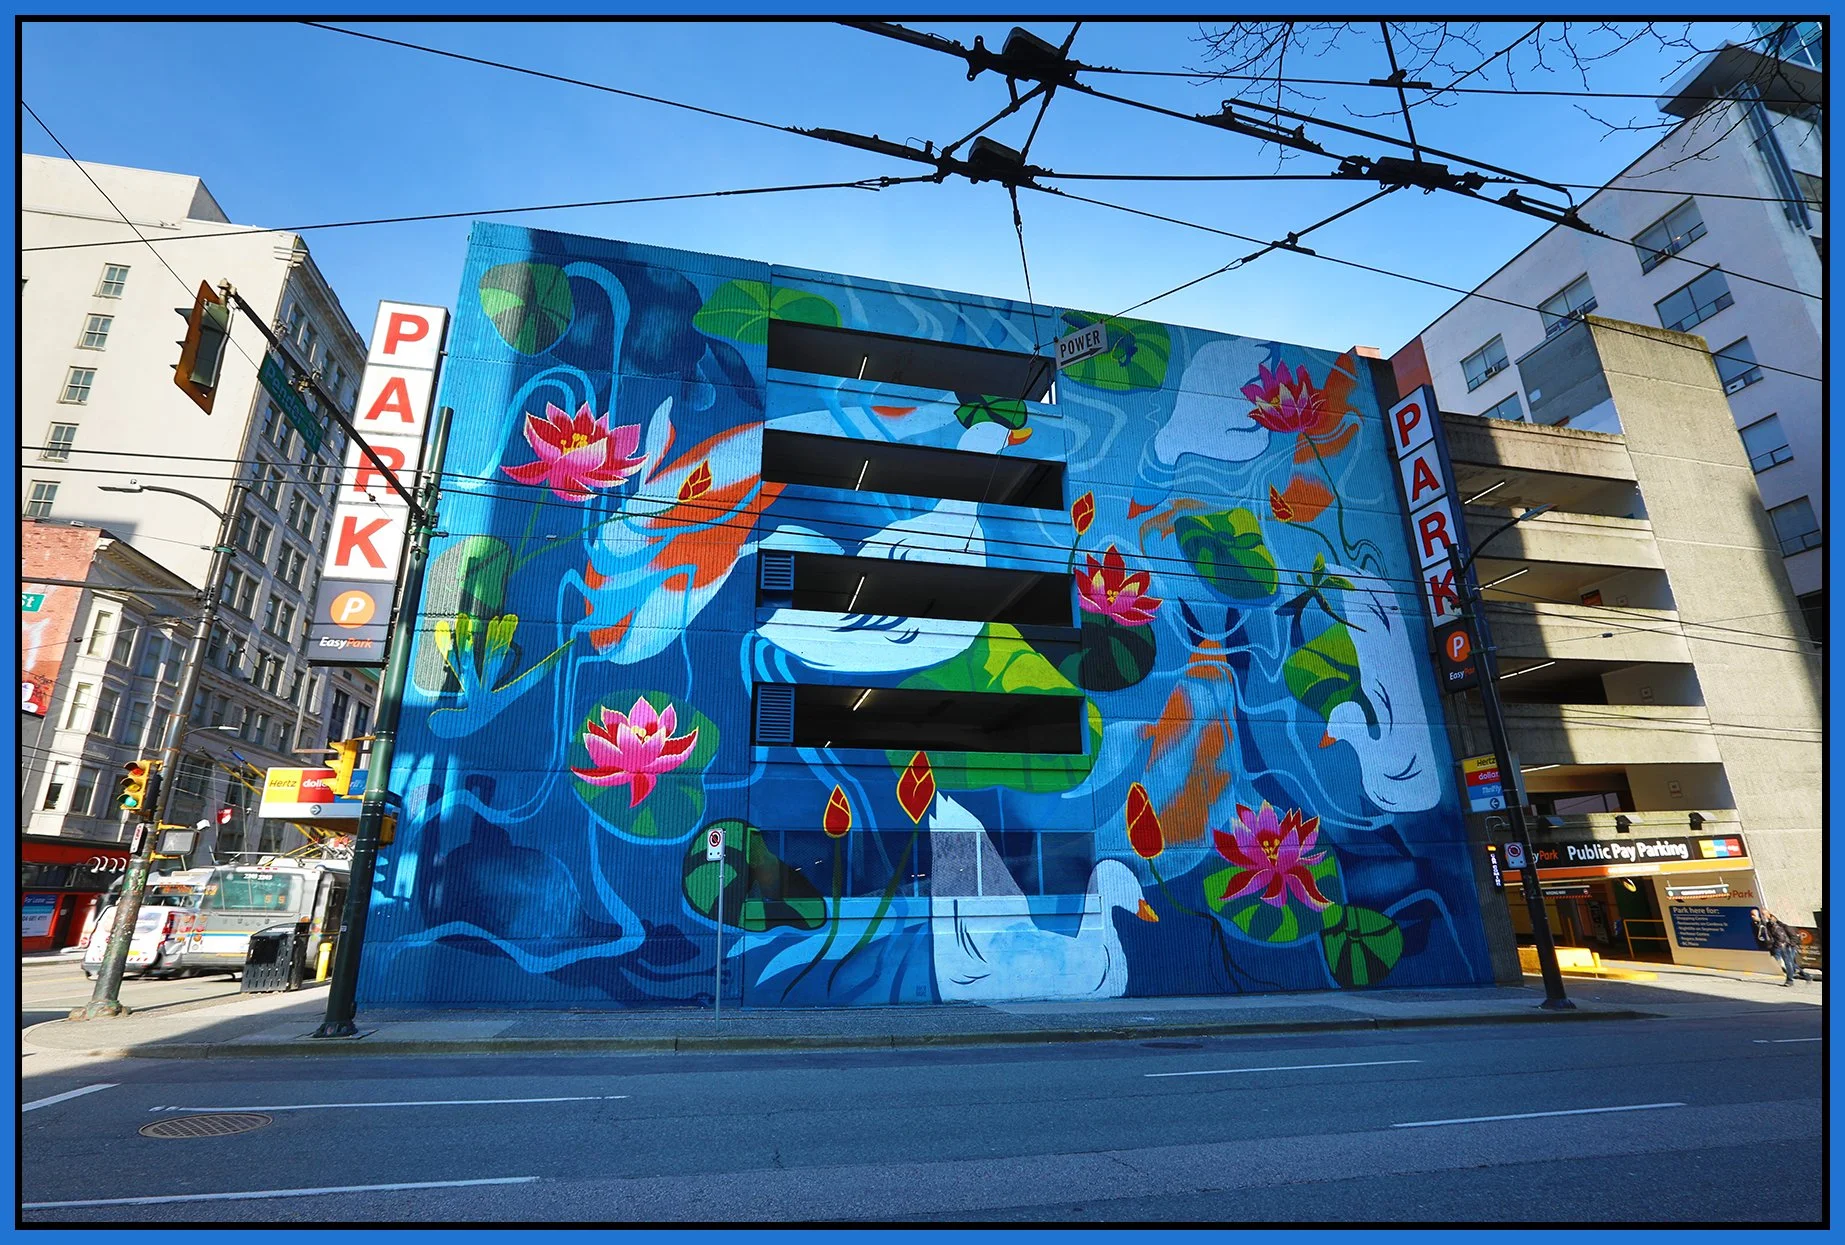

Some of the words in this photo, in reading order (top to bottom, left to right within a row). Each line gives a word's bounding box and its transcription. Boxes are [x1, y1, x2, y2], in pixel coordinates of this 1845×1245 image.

[1060, 330, 1100, 358] POWER
[265, 364, 305, 425] Pender
[305, 421, 322, 447] St
[334, 311, 430, 570] PARK
[1396, 402, 1460, 618] PARK
[341, 597, 366, 622] P
[319, 636, 373, 650] EasyPark
[1453, 636, 1465, 658] P
[1476, 757, 1496, 767] Hertz
[269, 779, 297, 788] Hertz
[1478, 771, 1499, 780] dollar
[1531, 849, 1559, 864] yPark
[1567, 844, 1611, 861] Public
[1610, 843, 1636, 862] Pay
[1636, 840, 1689, 859] Parking
[1728, 889, 1753, 900] yPark
